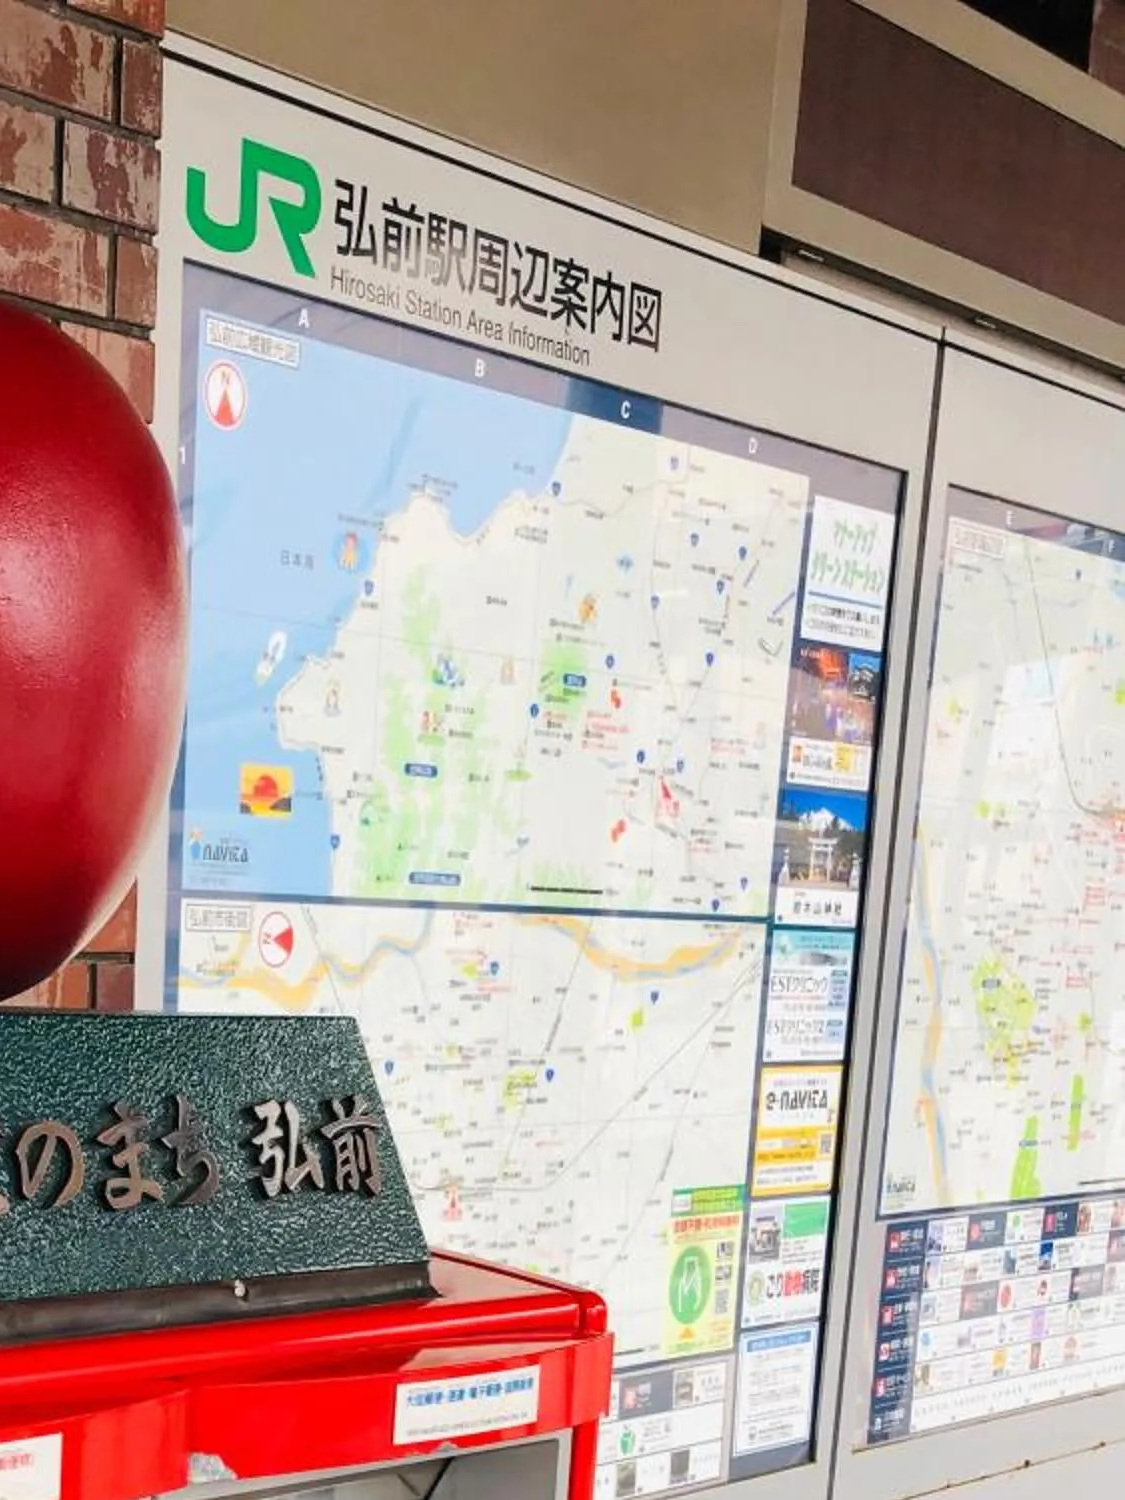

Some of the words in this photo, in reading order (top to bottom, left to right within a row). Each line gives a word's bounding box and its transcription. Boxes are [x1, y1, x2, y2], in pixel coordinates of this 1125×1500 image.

[186, 137, 322, 278] JR
[334, 179, 662, 353] 弘前駅周辺案内図
[330, 265, 401, 312] Hirosaki
[406, 289, 463, 329] Station
[466, 312, 504, 342] Area
[508, 321, 591, 367] Information
[251, 1095, 384, 1198] 弘前
